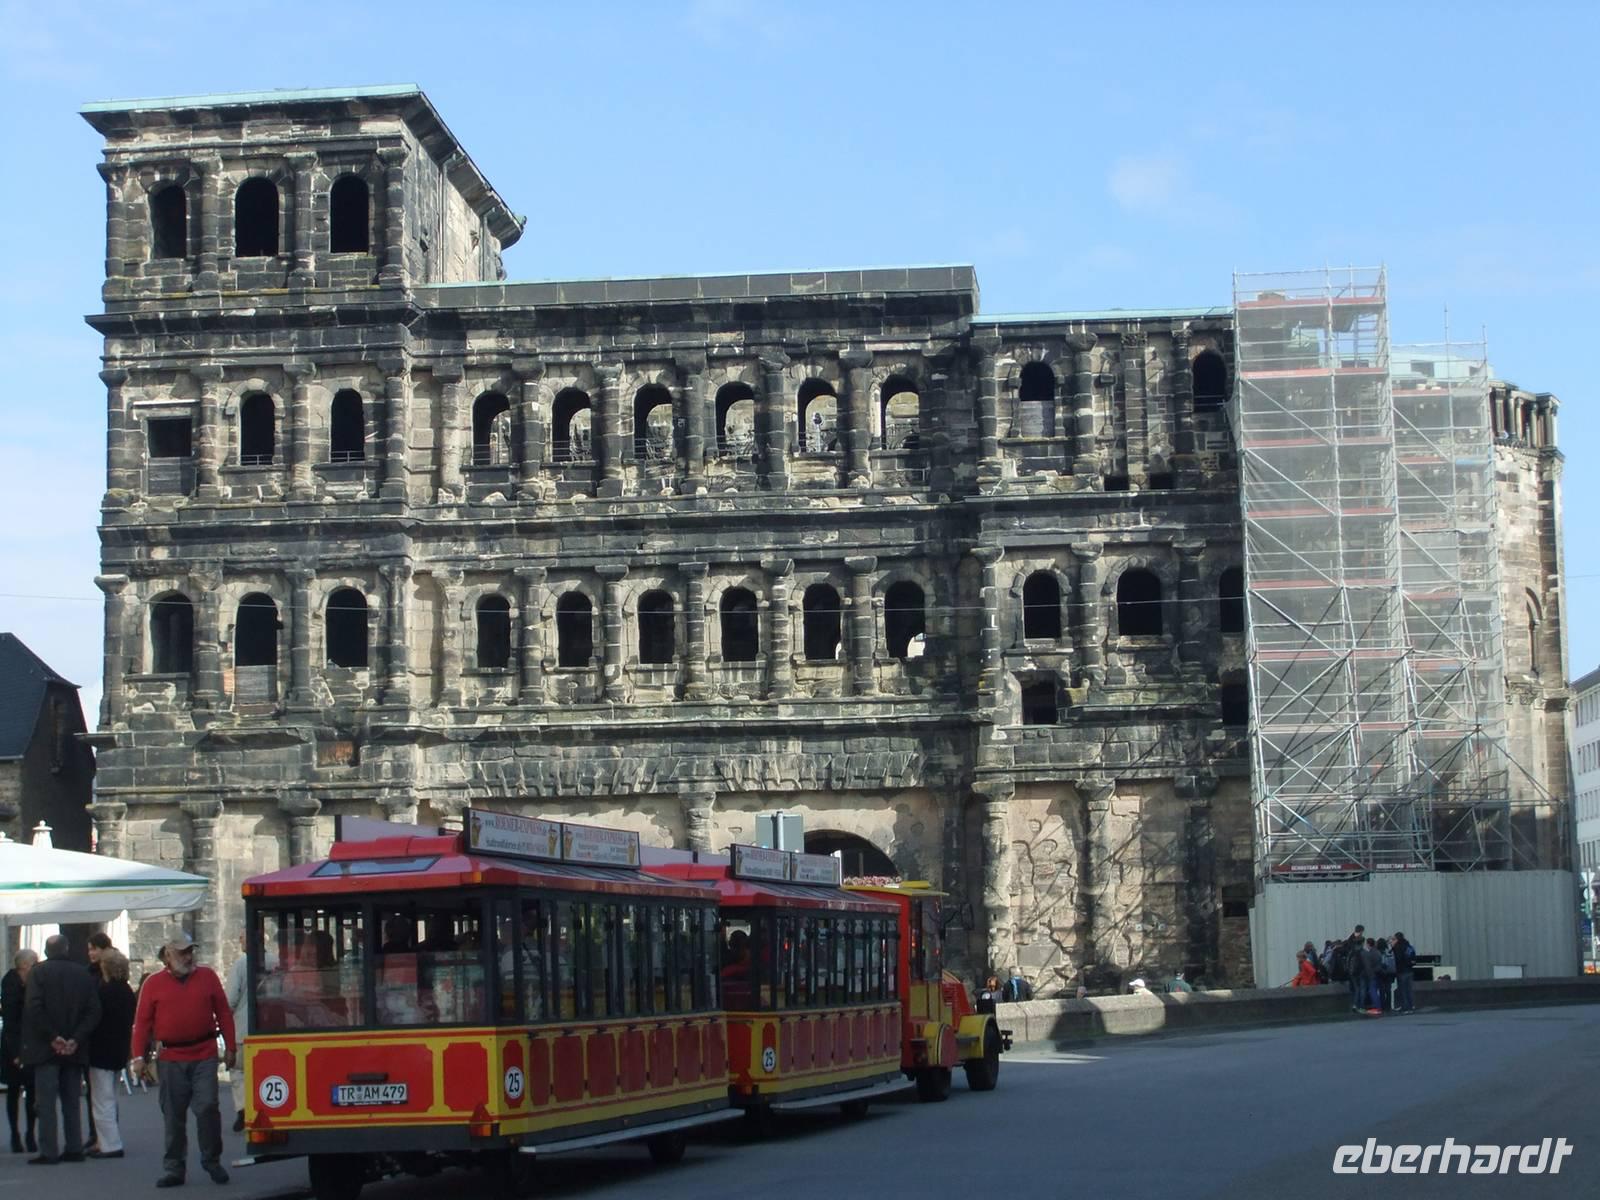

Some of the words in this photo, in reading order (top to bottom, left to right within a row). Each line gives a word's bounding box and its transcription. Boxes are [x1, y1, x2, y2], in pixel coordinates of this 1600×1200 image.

[765, 1050, 774, 1067] 25
[265, 1081, 283, 1101] 25
[508, 1072, 520, 1092] 25
[382, 1085, 405, 1098] 479
